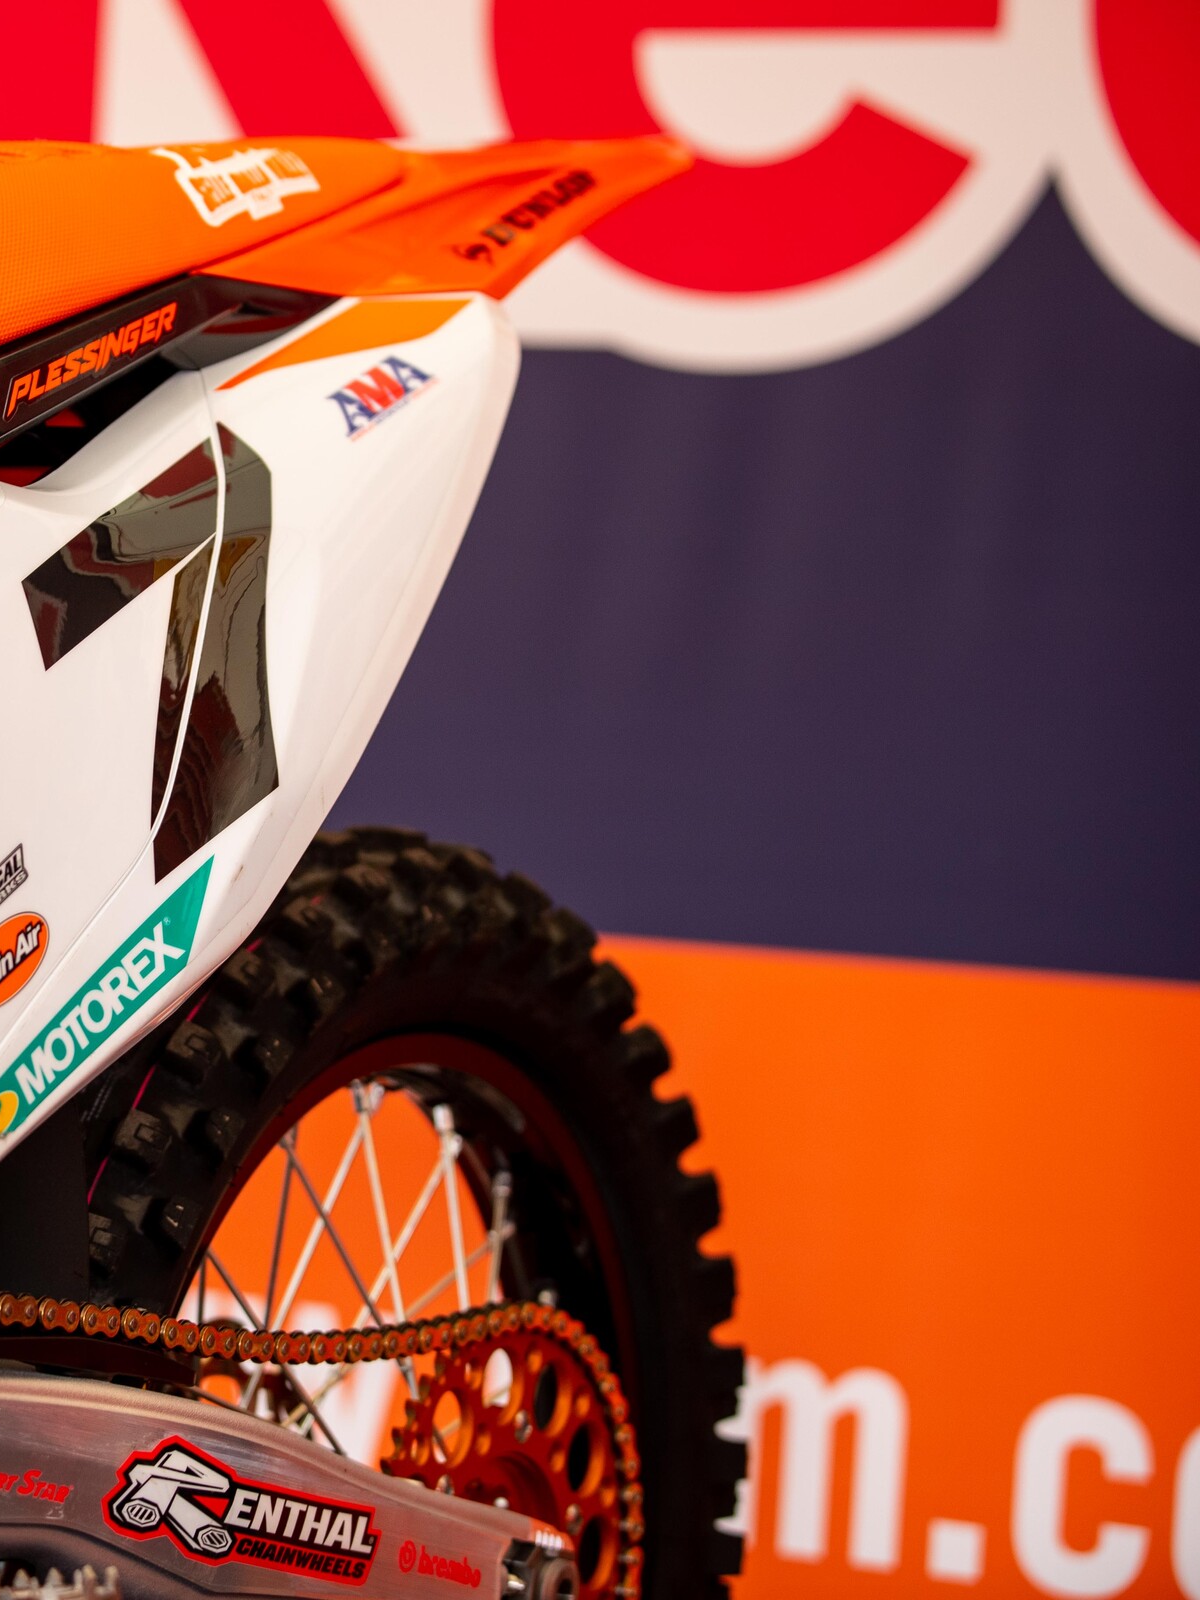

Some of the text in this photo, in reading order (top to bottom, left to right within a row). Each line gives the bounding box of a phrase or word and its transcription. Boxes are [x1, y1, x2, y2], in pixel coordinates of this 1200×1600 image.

[6, 302, 178, 418] PLESSINGER
[325, 356, 433, 437] AMA
[22, 423, 280, 882] 7
[14, 922, 42, 965] Air
[14, 921, 187, 1105] MOTOREX
[235, 1537, 367, 1580] CHAINWHEELS
[417, 1545, 482, 1589] brembo
